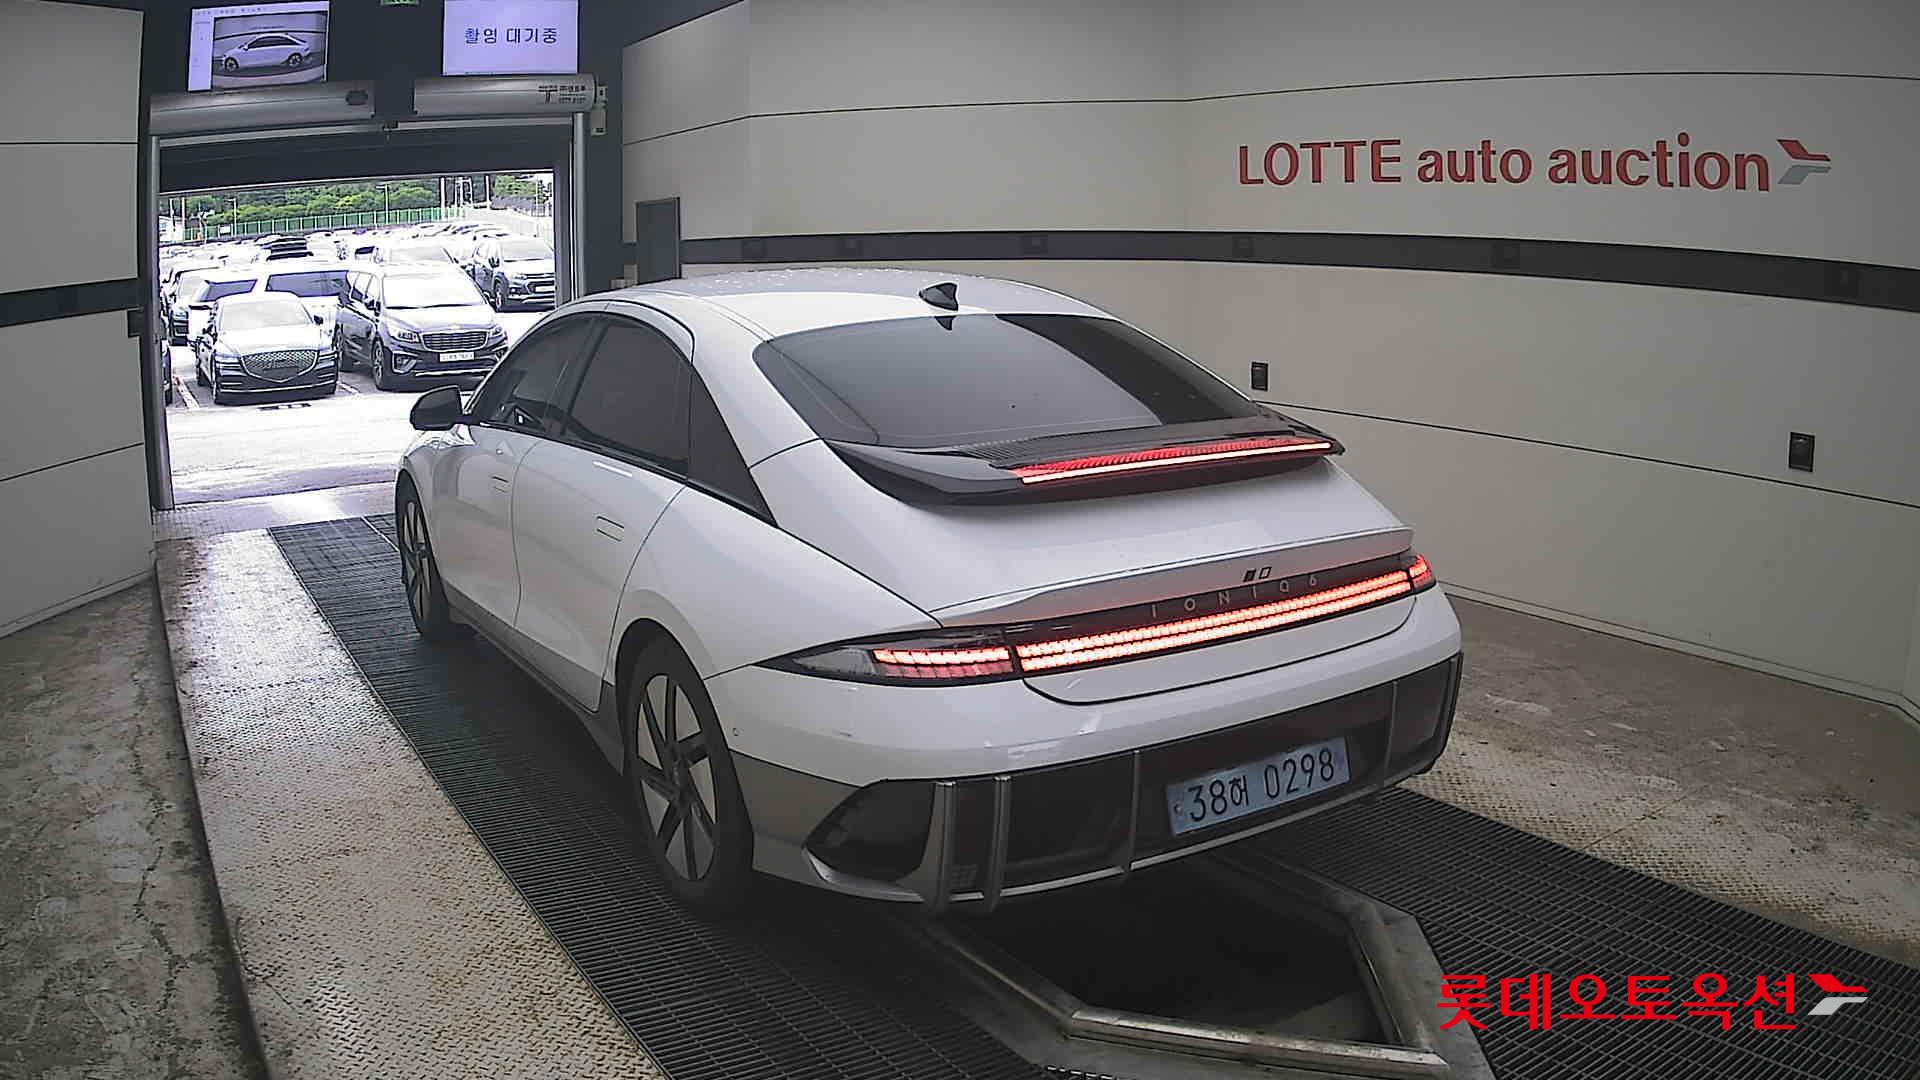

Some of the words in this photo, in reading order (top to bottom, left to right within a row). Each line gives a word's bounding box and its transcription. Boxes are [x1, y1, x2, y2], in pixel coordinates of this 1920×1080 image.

[465, 27, 498, 44] 촬영
[505, 27, 558, 44] 대기중
[1239, 139, 1401, 185] LOTTE
[1417, 139, 1533, 184] auto
[1547, 132, 1770, 191] auction
[1188, 775, 1249, 822] 38허
[1264, 747, 1334, 799] 0298
